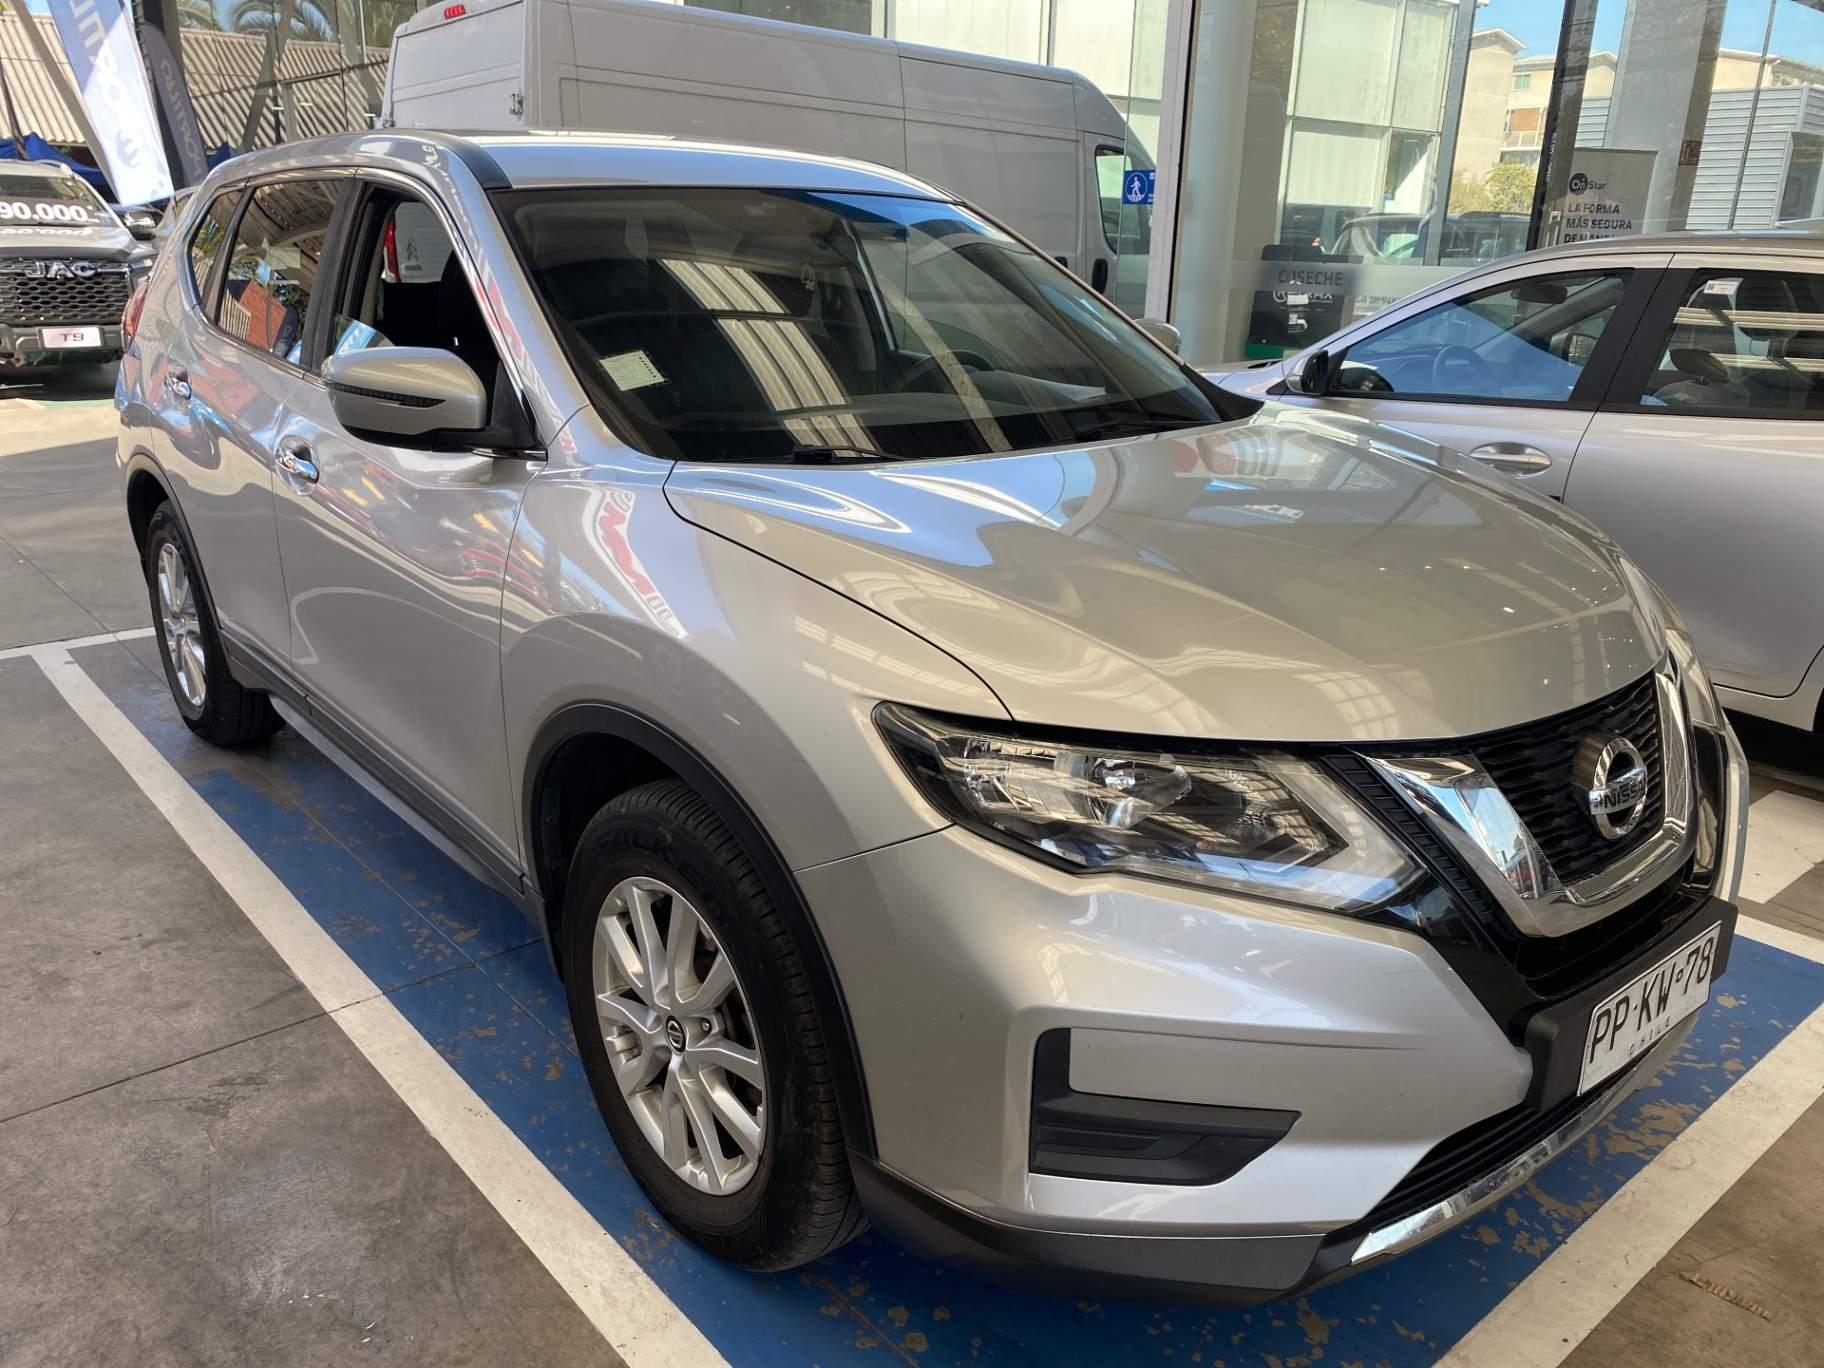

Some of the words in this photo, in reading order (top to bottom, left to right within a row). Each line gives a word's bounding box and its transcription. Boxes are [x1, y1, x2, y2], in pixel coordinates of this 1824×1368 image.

[1568, 203, 1579, 213] LA
[1583, 203, 1620, 214] FORMA
[1566, 216, 1589, 229] MÁS
[1591, 218, 1632, 230] SEGURA
[25, 261, 98, 278] JAC
[1278, 269, 1344, 287] COSECHE
[1629, 1015, 1671, 1056] CHILE
